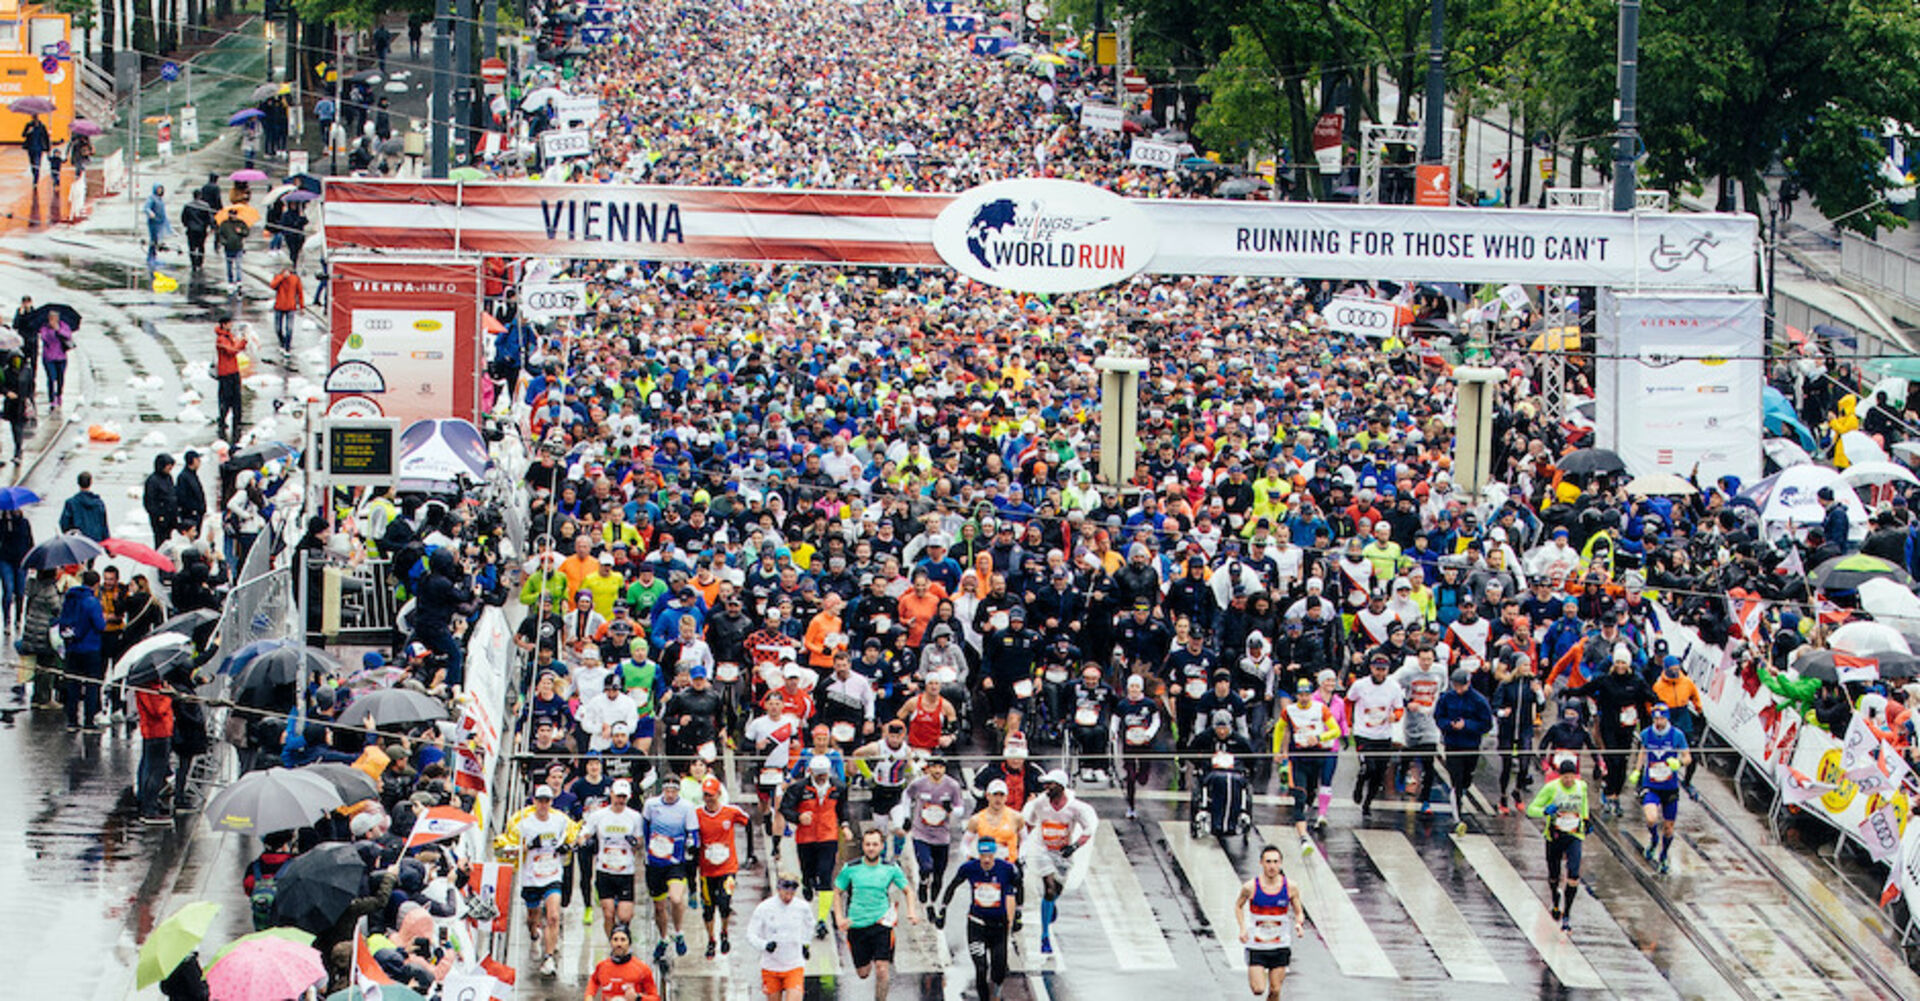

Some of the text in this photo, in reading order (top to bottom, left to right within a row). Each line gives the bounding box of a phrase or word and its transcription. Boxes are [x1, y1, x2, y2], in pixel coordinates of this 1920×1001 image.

[541, 200, 684, 243] VIENNA
[993, 241, 1125, 269] WORLD RUN
[1236, 228, 1610, 261] RUNNING FOR THOSE WHO CAN'T
[353, 281, 457, 293] VIENNA.INFO
